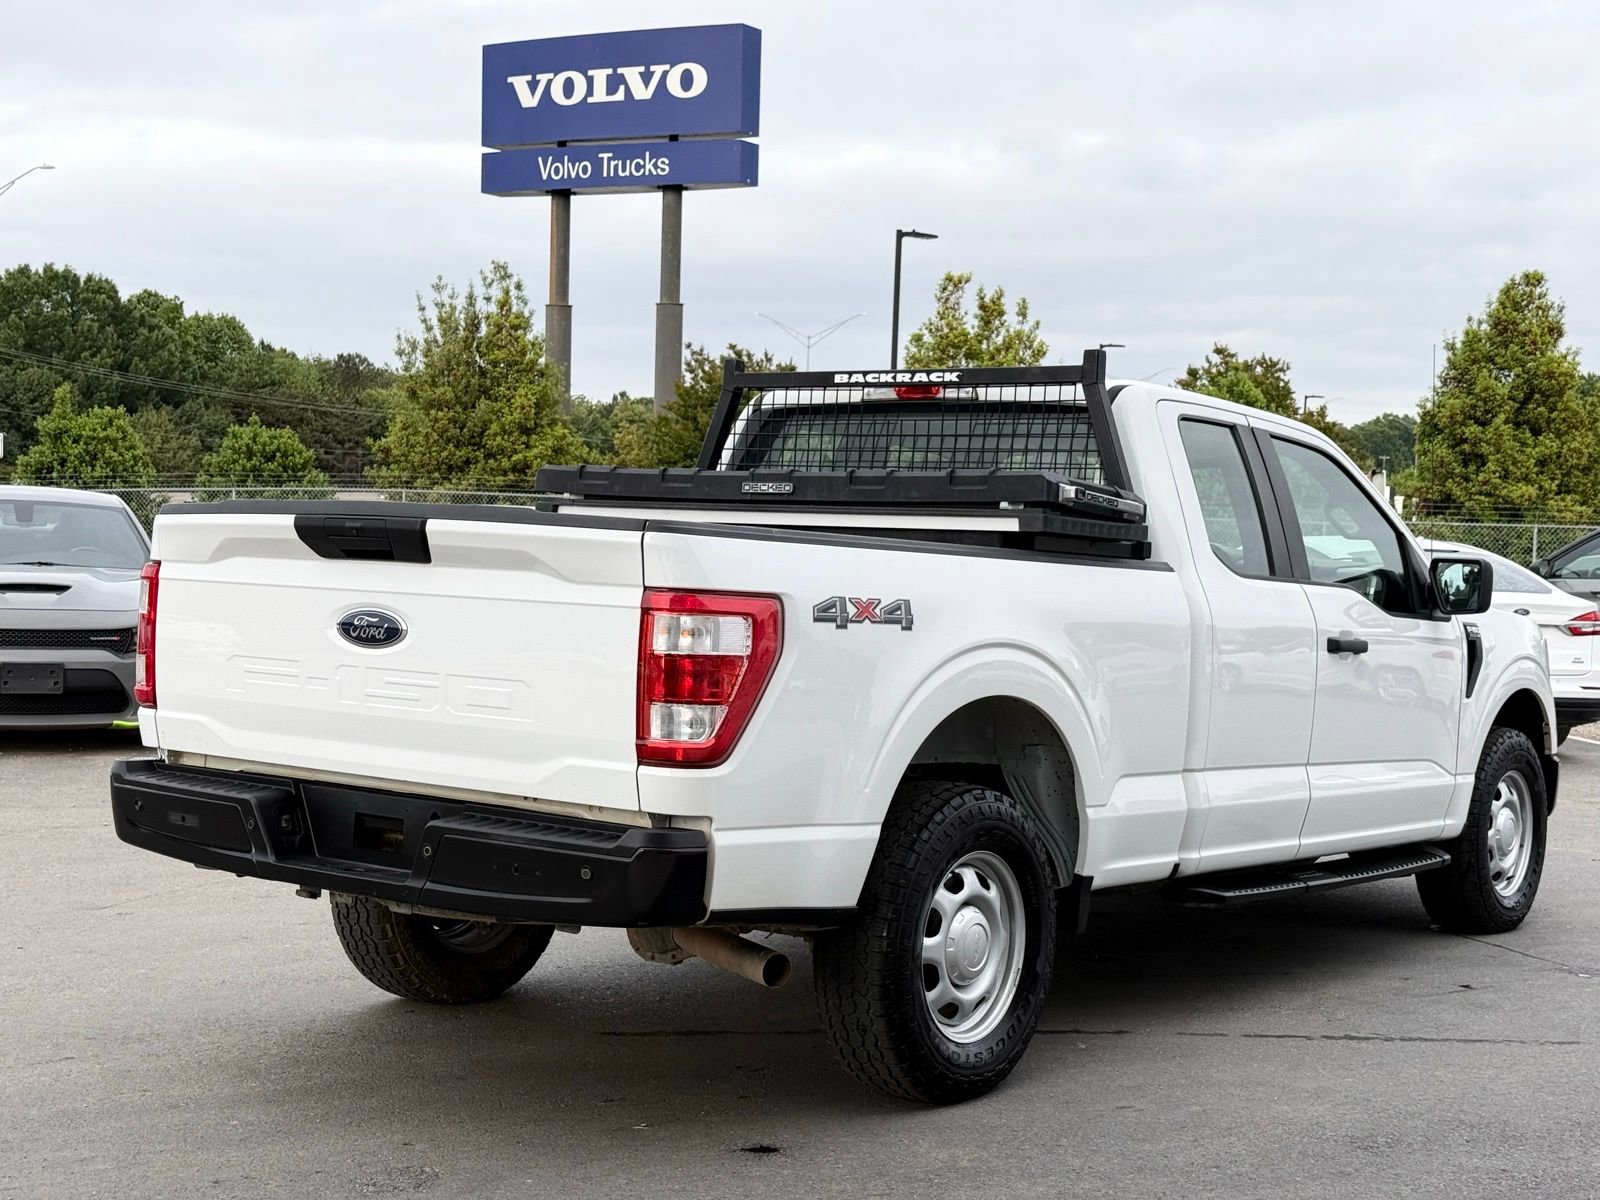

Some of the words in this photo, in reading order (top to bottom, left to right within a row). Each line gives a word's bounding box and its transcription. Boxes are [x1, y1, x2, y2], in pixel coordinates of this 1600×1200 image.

[507, 62, 708, 108] VOLVO
[538, 155, 592, 180] Volvo
[598, 151, 670, 178] Trucks
[834, 372, 961, 384] BACKRACK
[742, 482, 793, 494] DECKED
[350, 615, 388, 639] Ford
